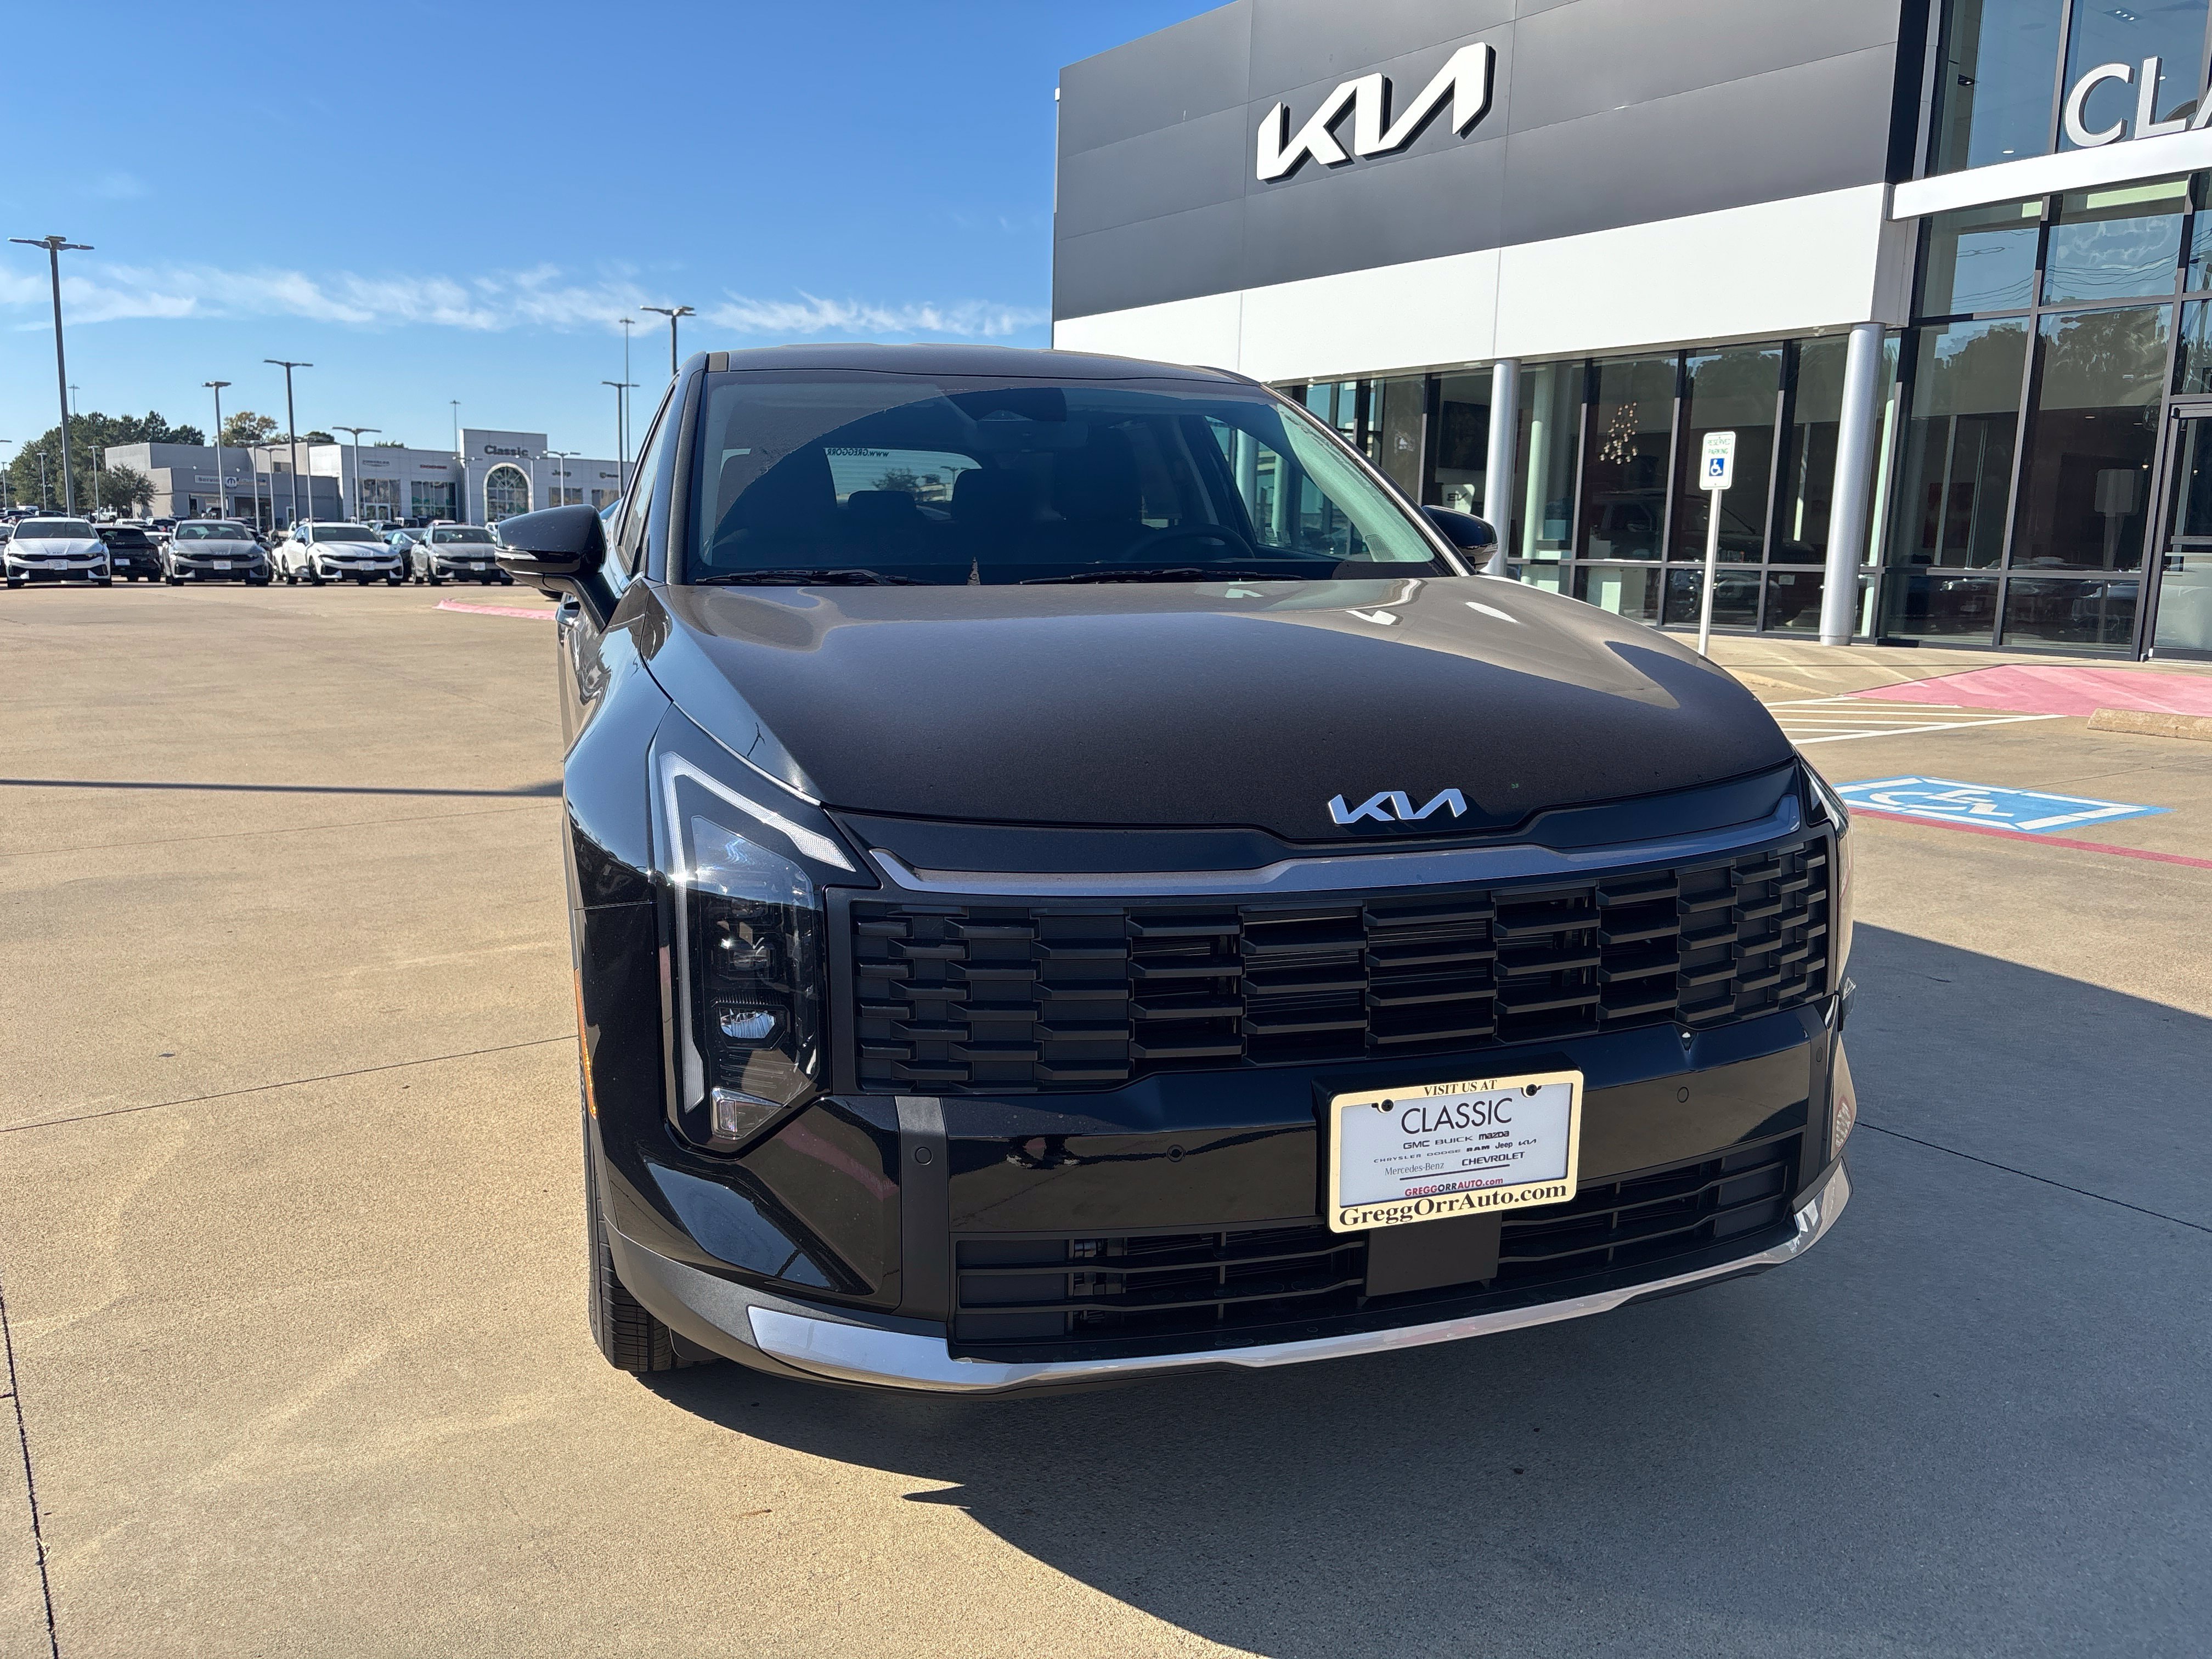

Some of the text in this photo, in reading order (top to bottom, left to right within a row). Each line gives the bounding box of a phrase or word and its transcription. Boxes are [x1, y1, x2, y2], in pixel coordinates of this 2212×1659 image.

[1256, 42, 1491, 182] KIA
[484, 445, 528, 456] Classic
[1328, 788, 1468, 824] KIA
[1424, 1079, 1498, 1096] VISIT US AT
[1401, 1097, 1513, 1135] CLASSIC
[1403, 1140, 1430, 1149] GMC
[1435, 1135, 1474, 1146] BUICK
[1373, 1154, 1421, 1163] CHRYSLER
[1384, 1151, 1526, 1176] Mercedes-Benz CHEVROLET
[1404, 1177, 1504, 1197] GREGGORRAUTO.com
[1339, 1184, 1567, 1226] GreggOrrAuto.com
